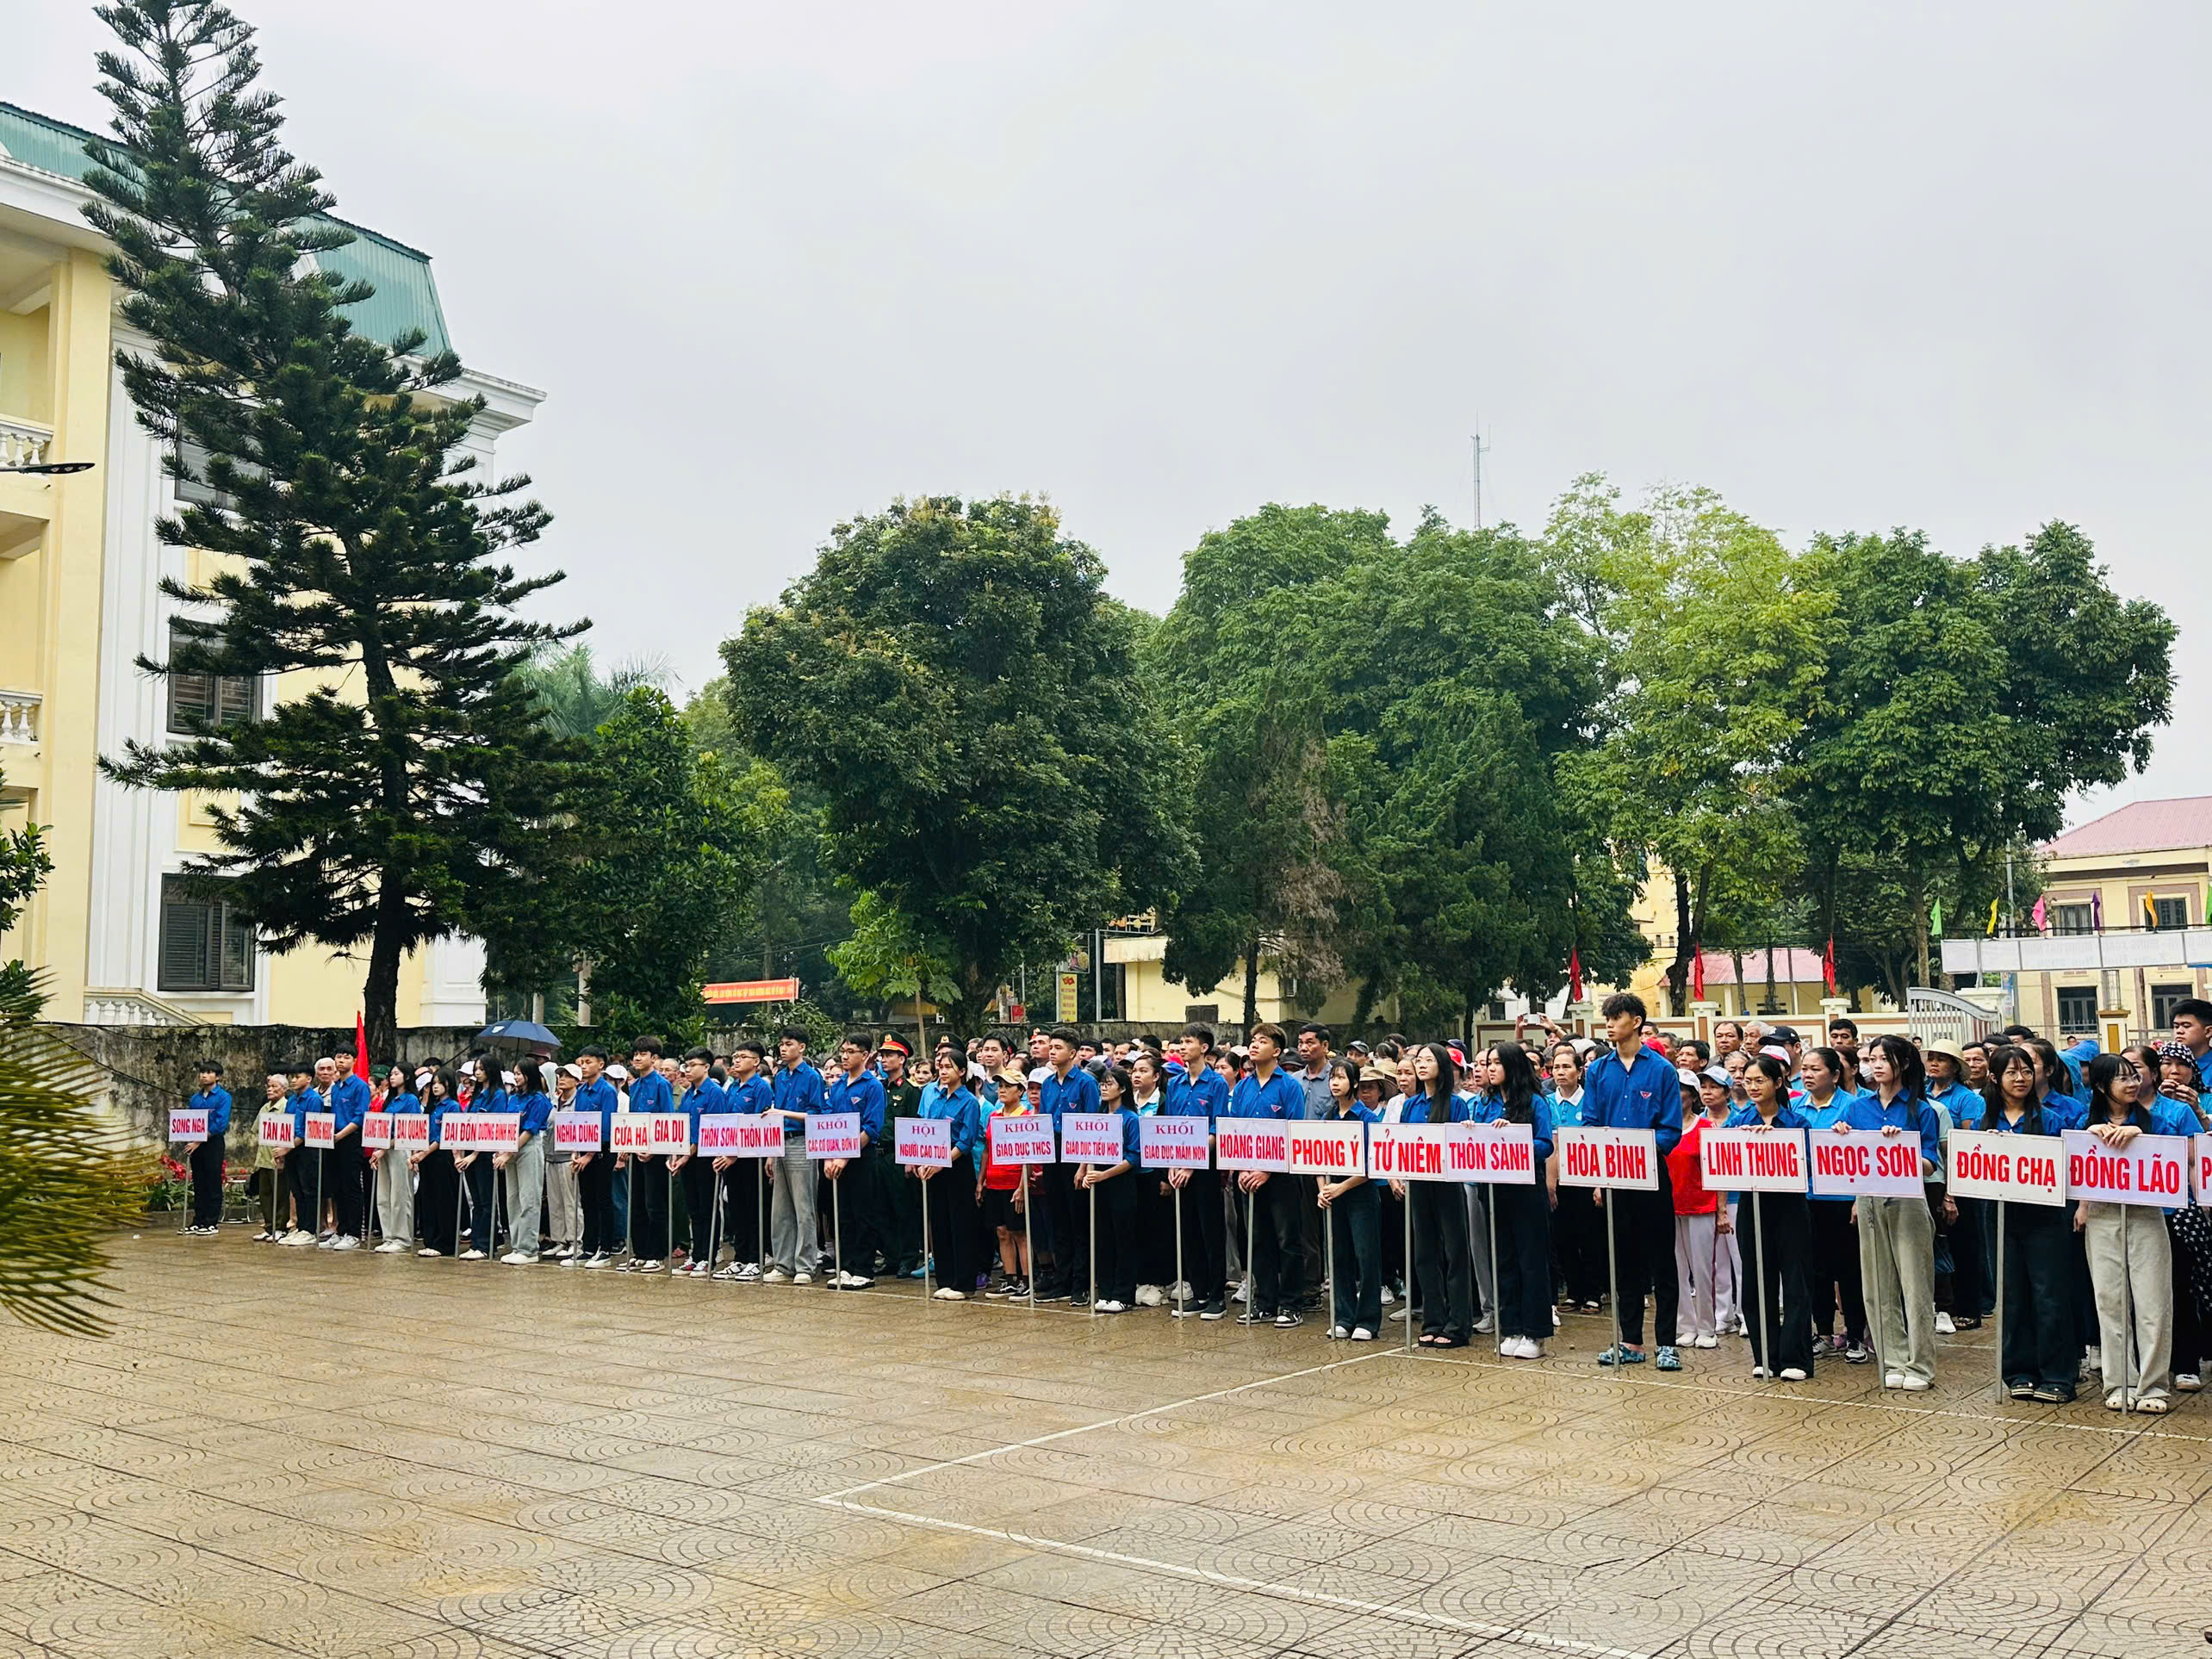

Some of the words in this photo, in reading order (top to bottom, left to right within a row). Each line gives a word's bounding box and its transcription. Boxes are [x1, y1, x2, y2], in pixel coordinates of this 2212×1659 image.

[263, 1118, 277, 1140] TÂN
[280, 1122, 291, 1141] AN
[654, 1119, 669, 1142] GIA
[672, 1120, 684, 1148] DỤ
[701, 1123, 719, 1147] THÔN
[740, 1123, 761, 1148] THÔN
[817, 1117, 848, 1130] KHỐI
[912, 1123, 935, 1137] HỘI
[1005, 1118, 1040, 1132] KHỐI
[1075, 1119, 1109, 1131] KHỐI
[1156, 1121, 1194, 1135] KHỐI
[920, 1145, 932, 1158] CAO
[1032, 1141, 1051, 1156] THCS
[1161, 1146, 1174, 1162] DỤC
[1193, 1146, 1206, 1160] NON
[1220, 1130, 1253, 1158] HOÀNG
[1256, 1135, 1285, 1160] GIANG
[1292, 1139, 1345, 1167] PHONG
[1350, 1135, 1359, 1167] Ý
[1373, 1129, 1395, 1171] TỬ
[1398, 1136, 1441, 1174] NIÊM
[1449, 1137, 1486, 1169] THÔN
[1490, 1137, 1530, 1171] SÀNH
[1566, 1135, 1600, 1177] HÒA
[1605, 1137, 1646, 1179] BÌNH
[1707, 1142, 1743, 1176] LINH
[1746, 1142, 1798, 1177] THUNG
[1816, 1145, 1870, 1182] NGỌC
[1876, 1144, 1917, 1177] SƠN
[1956, 1144, 2009, 1182] ĐỒNG
[2017, 1156, 2056, 1192] CHẠ
[2070, 1145, 2130, 1190] ĐỒNG
[2138, 1153, 2179, 1195] LÃO
